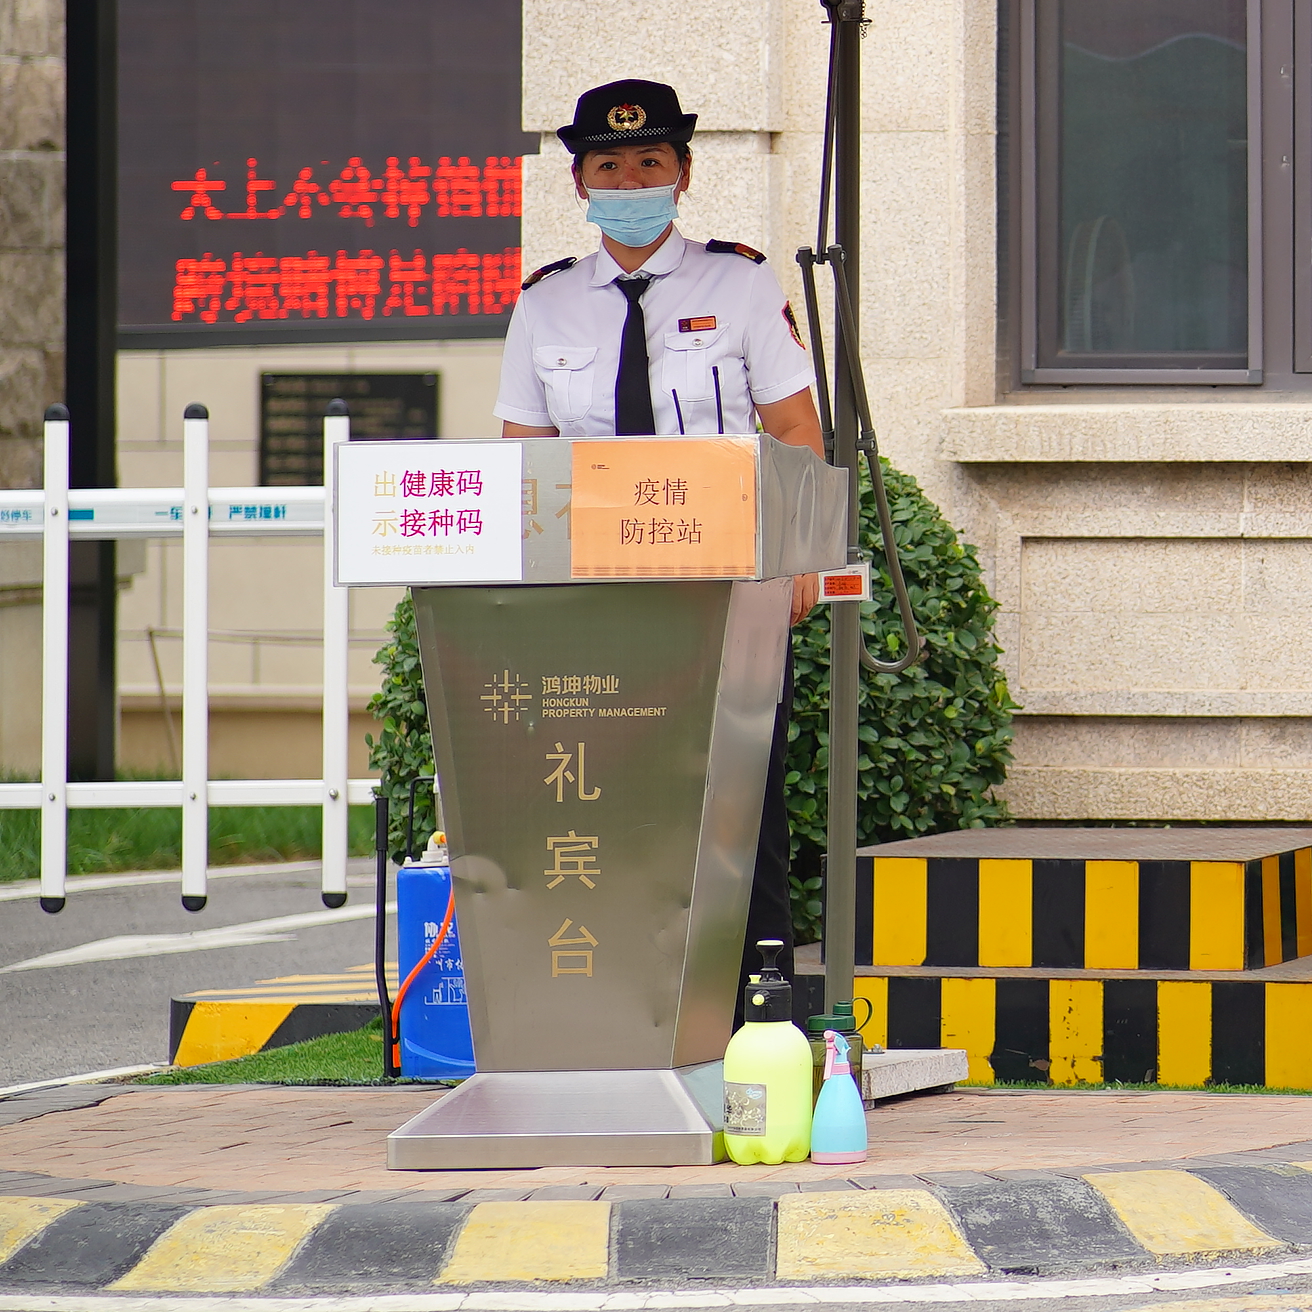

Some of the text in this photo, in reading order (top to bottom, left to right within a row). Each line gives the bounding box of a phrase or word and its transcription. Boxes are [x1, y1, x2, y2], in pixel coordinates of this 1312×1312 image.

[634, 477, 689, 506] 疫情
[620, 516, 703, 546] 防控站
[371, 543, 475, 556] 未接种疫苗者禁止入内
[541, 674, 620, 695] 鸿坤物业
[542, 698, 589, 707] HONGKUN
[542, 707, 667, 718] PROPERTY MANAGEMENT
[543, 741, 602, 978] 礼宾台
